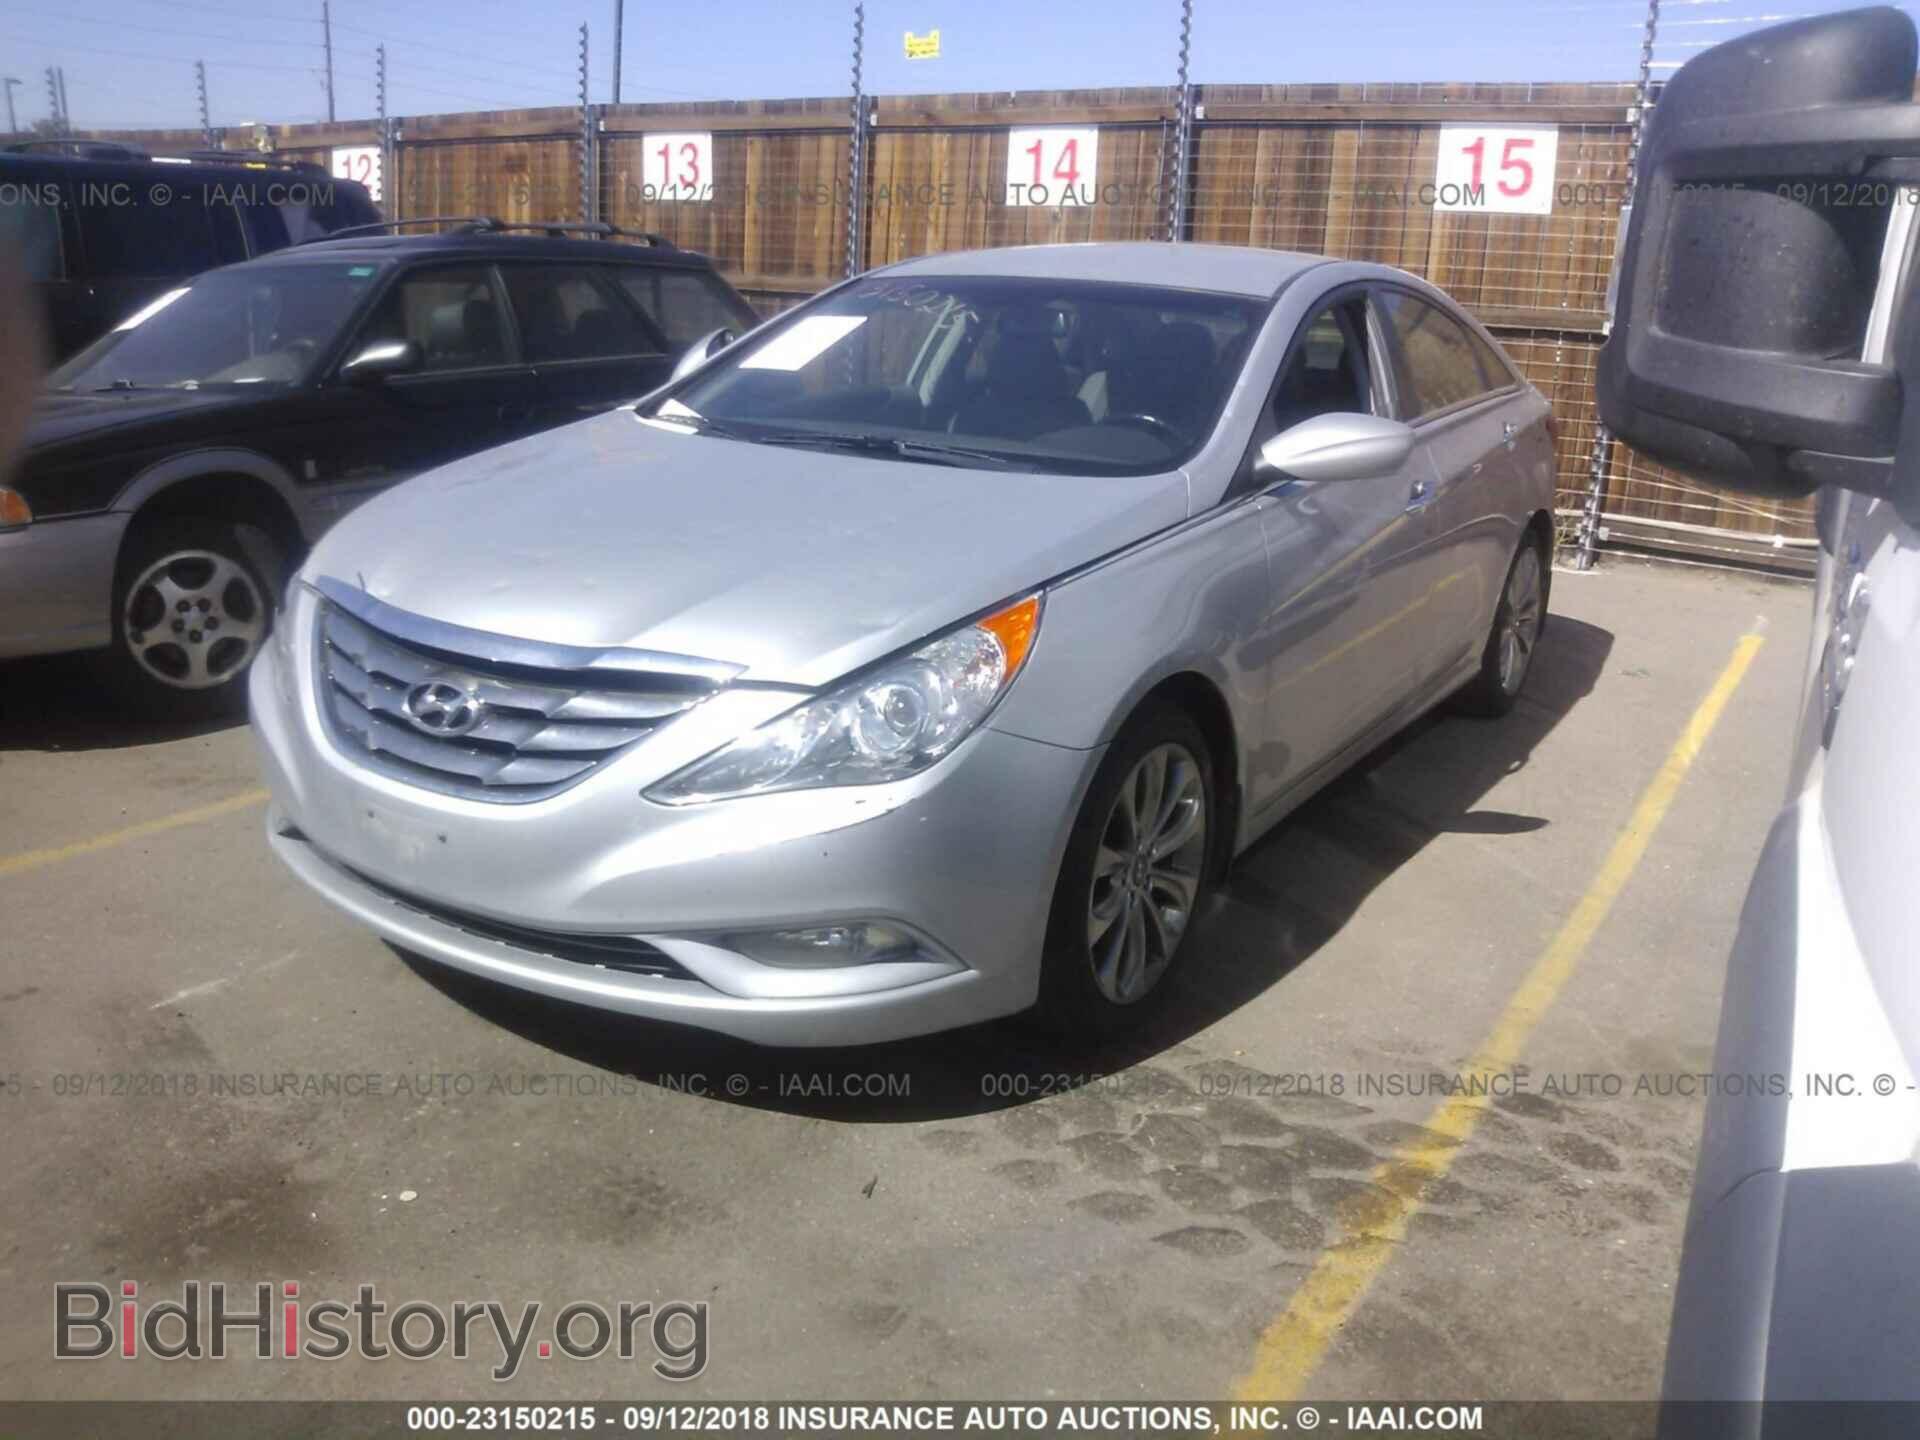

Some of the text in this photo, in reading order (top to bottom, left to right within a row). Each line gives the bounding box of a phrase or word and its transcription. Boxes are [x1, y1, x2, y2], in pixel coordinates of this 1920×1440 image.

[342, 153, 373, 194] 12
[657, 142, 700, 188] 13
[1025, 138, 1080, 187] 14
[1461, 136, 1535, 198] 15
